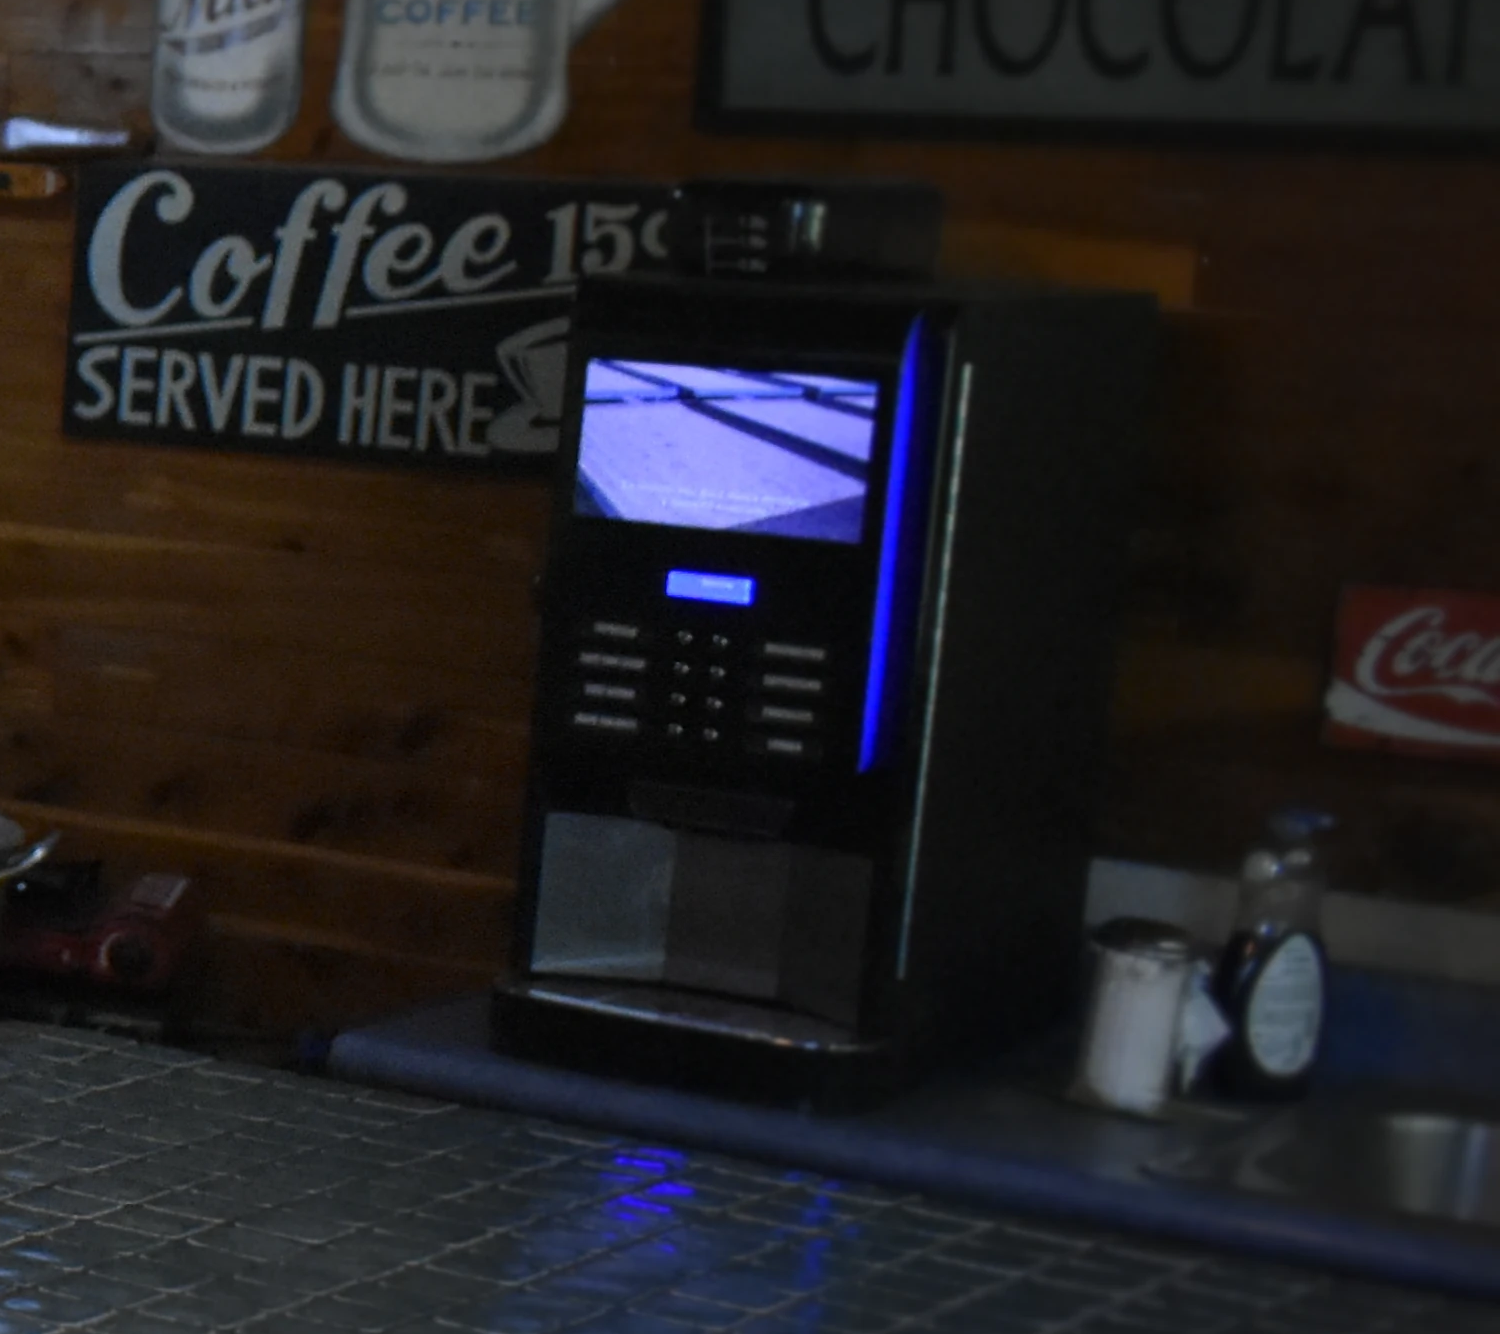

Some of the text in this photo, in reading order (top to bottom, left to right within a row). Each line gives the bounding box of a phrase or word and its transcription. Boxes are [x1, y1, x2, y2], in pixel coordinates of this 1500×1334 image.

[86, 169, 518, 331] Coffee
[73, 345, 498, 457] SERVED HERE
